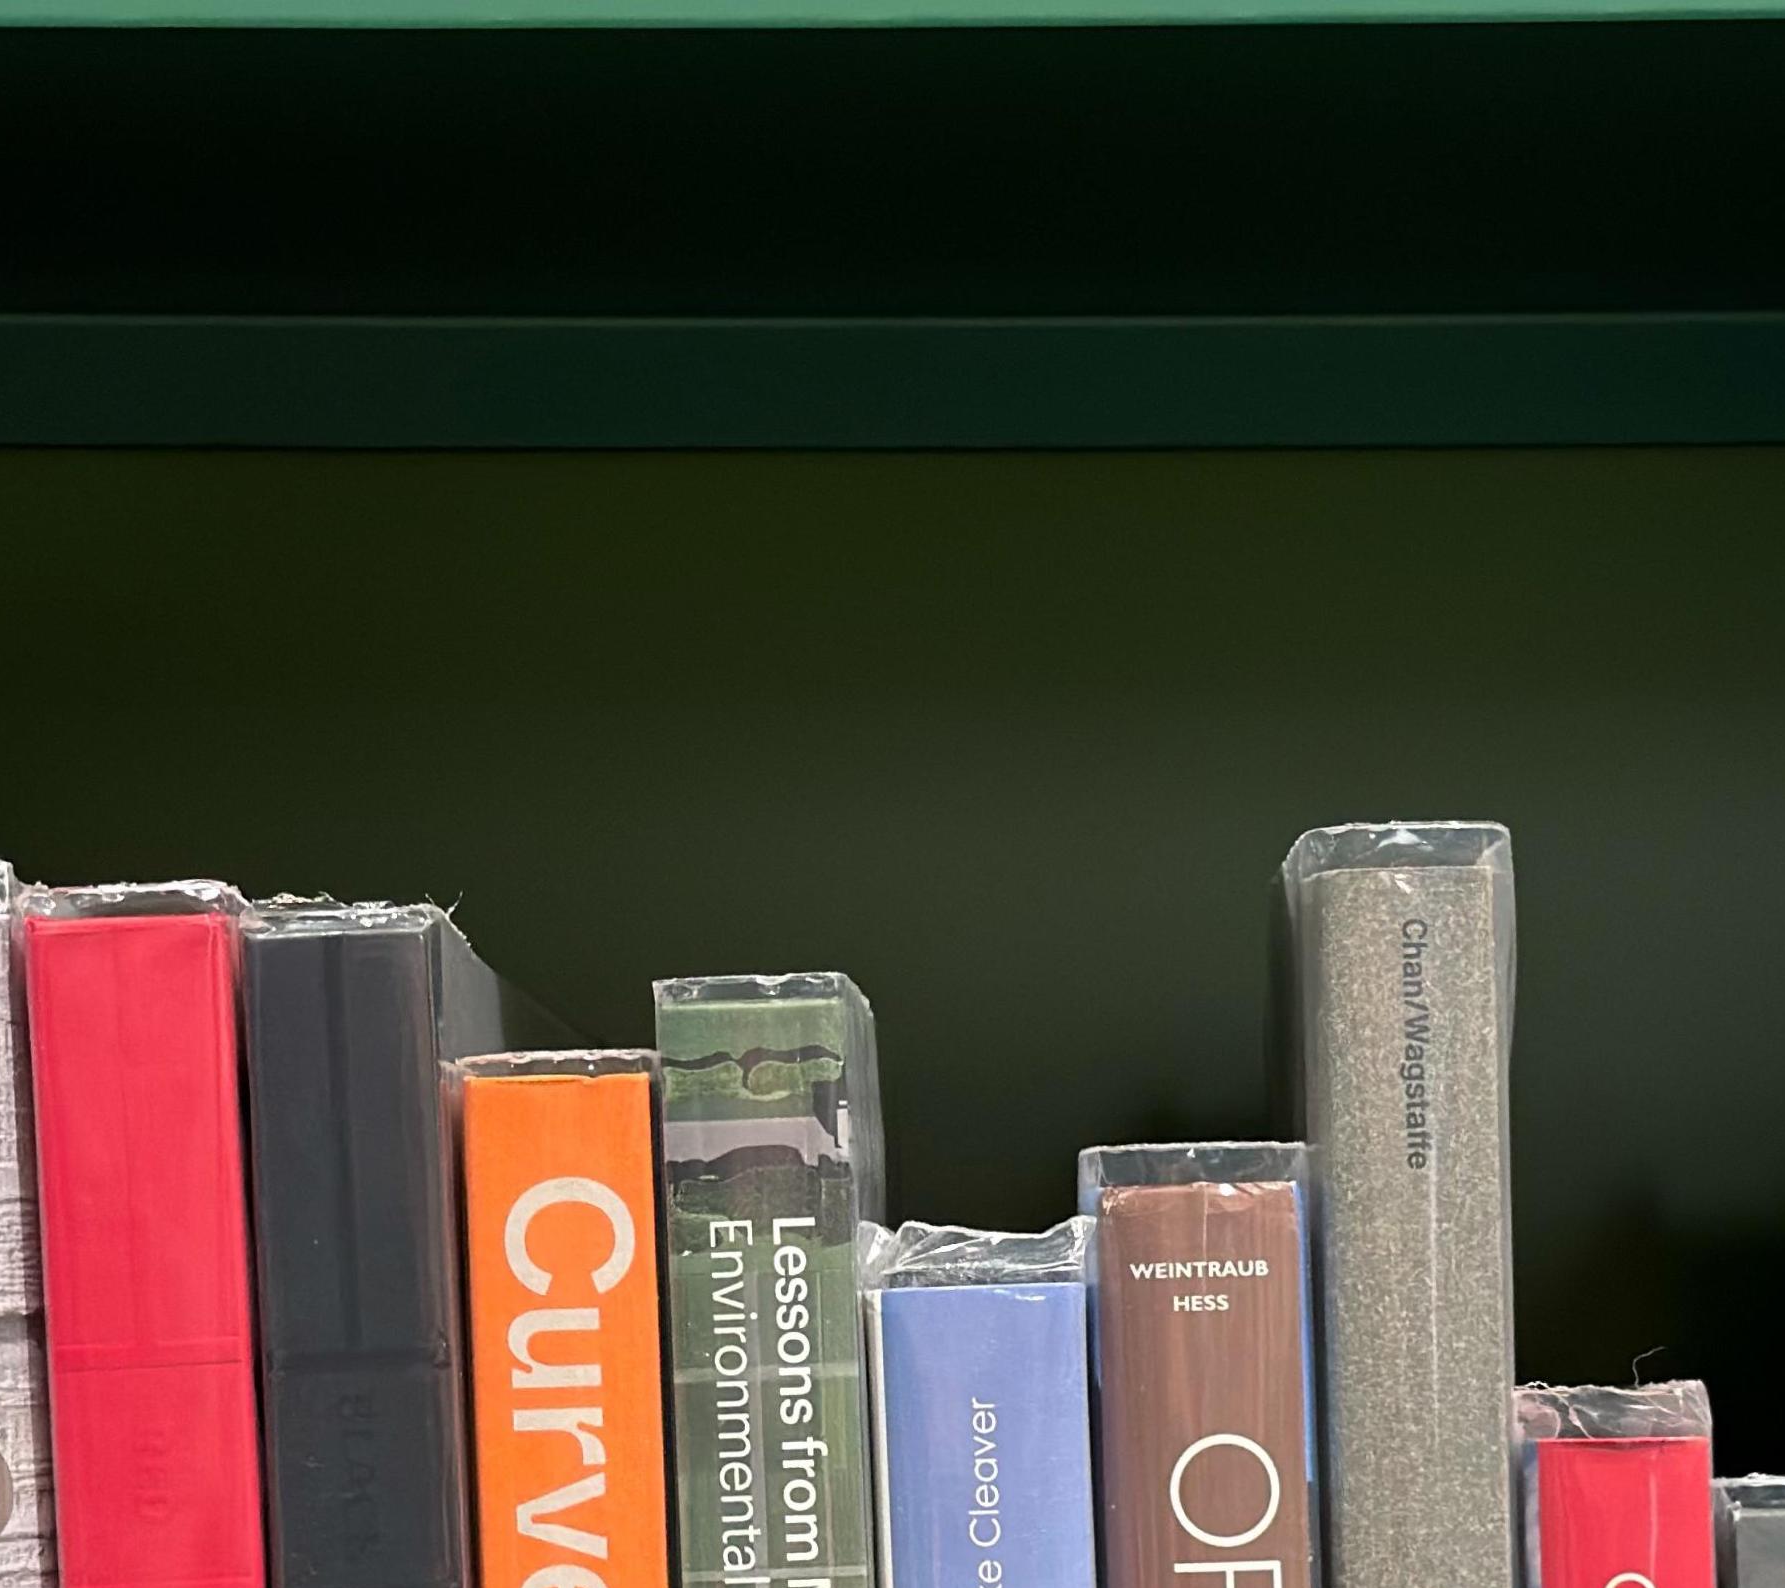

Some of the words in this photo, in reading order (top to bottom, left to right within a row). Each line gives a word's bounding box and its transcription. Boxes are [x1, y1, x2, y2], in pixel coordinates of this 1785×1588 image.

[1401, 917, 1435, 1171] Chan/Wagstaffe
[771, 1215, 817, 1427] Lessons
[1129, 1258, 1269, 1281] WEINTRAUB
[1172, 1294, 1229, 1313] HESS
[707, 1217, 766, 1585] Environmental
[968, 1396, 1002, 1552] Cleaver
[781, 1437, 828, 1564] from
